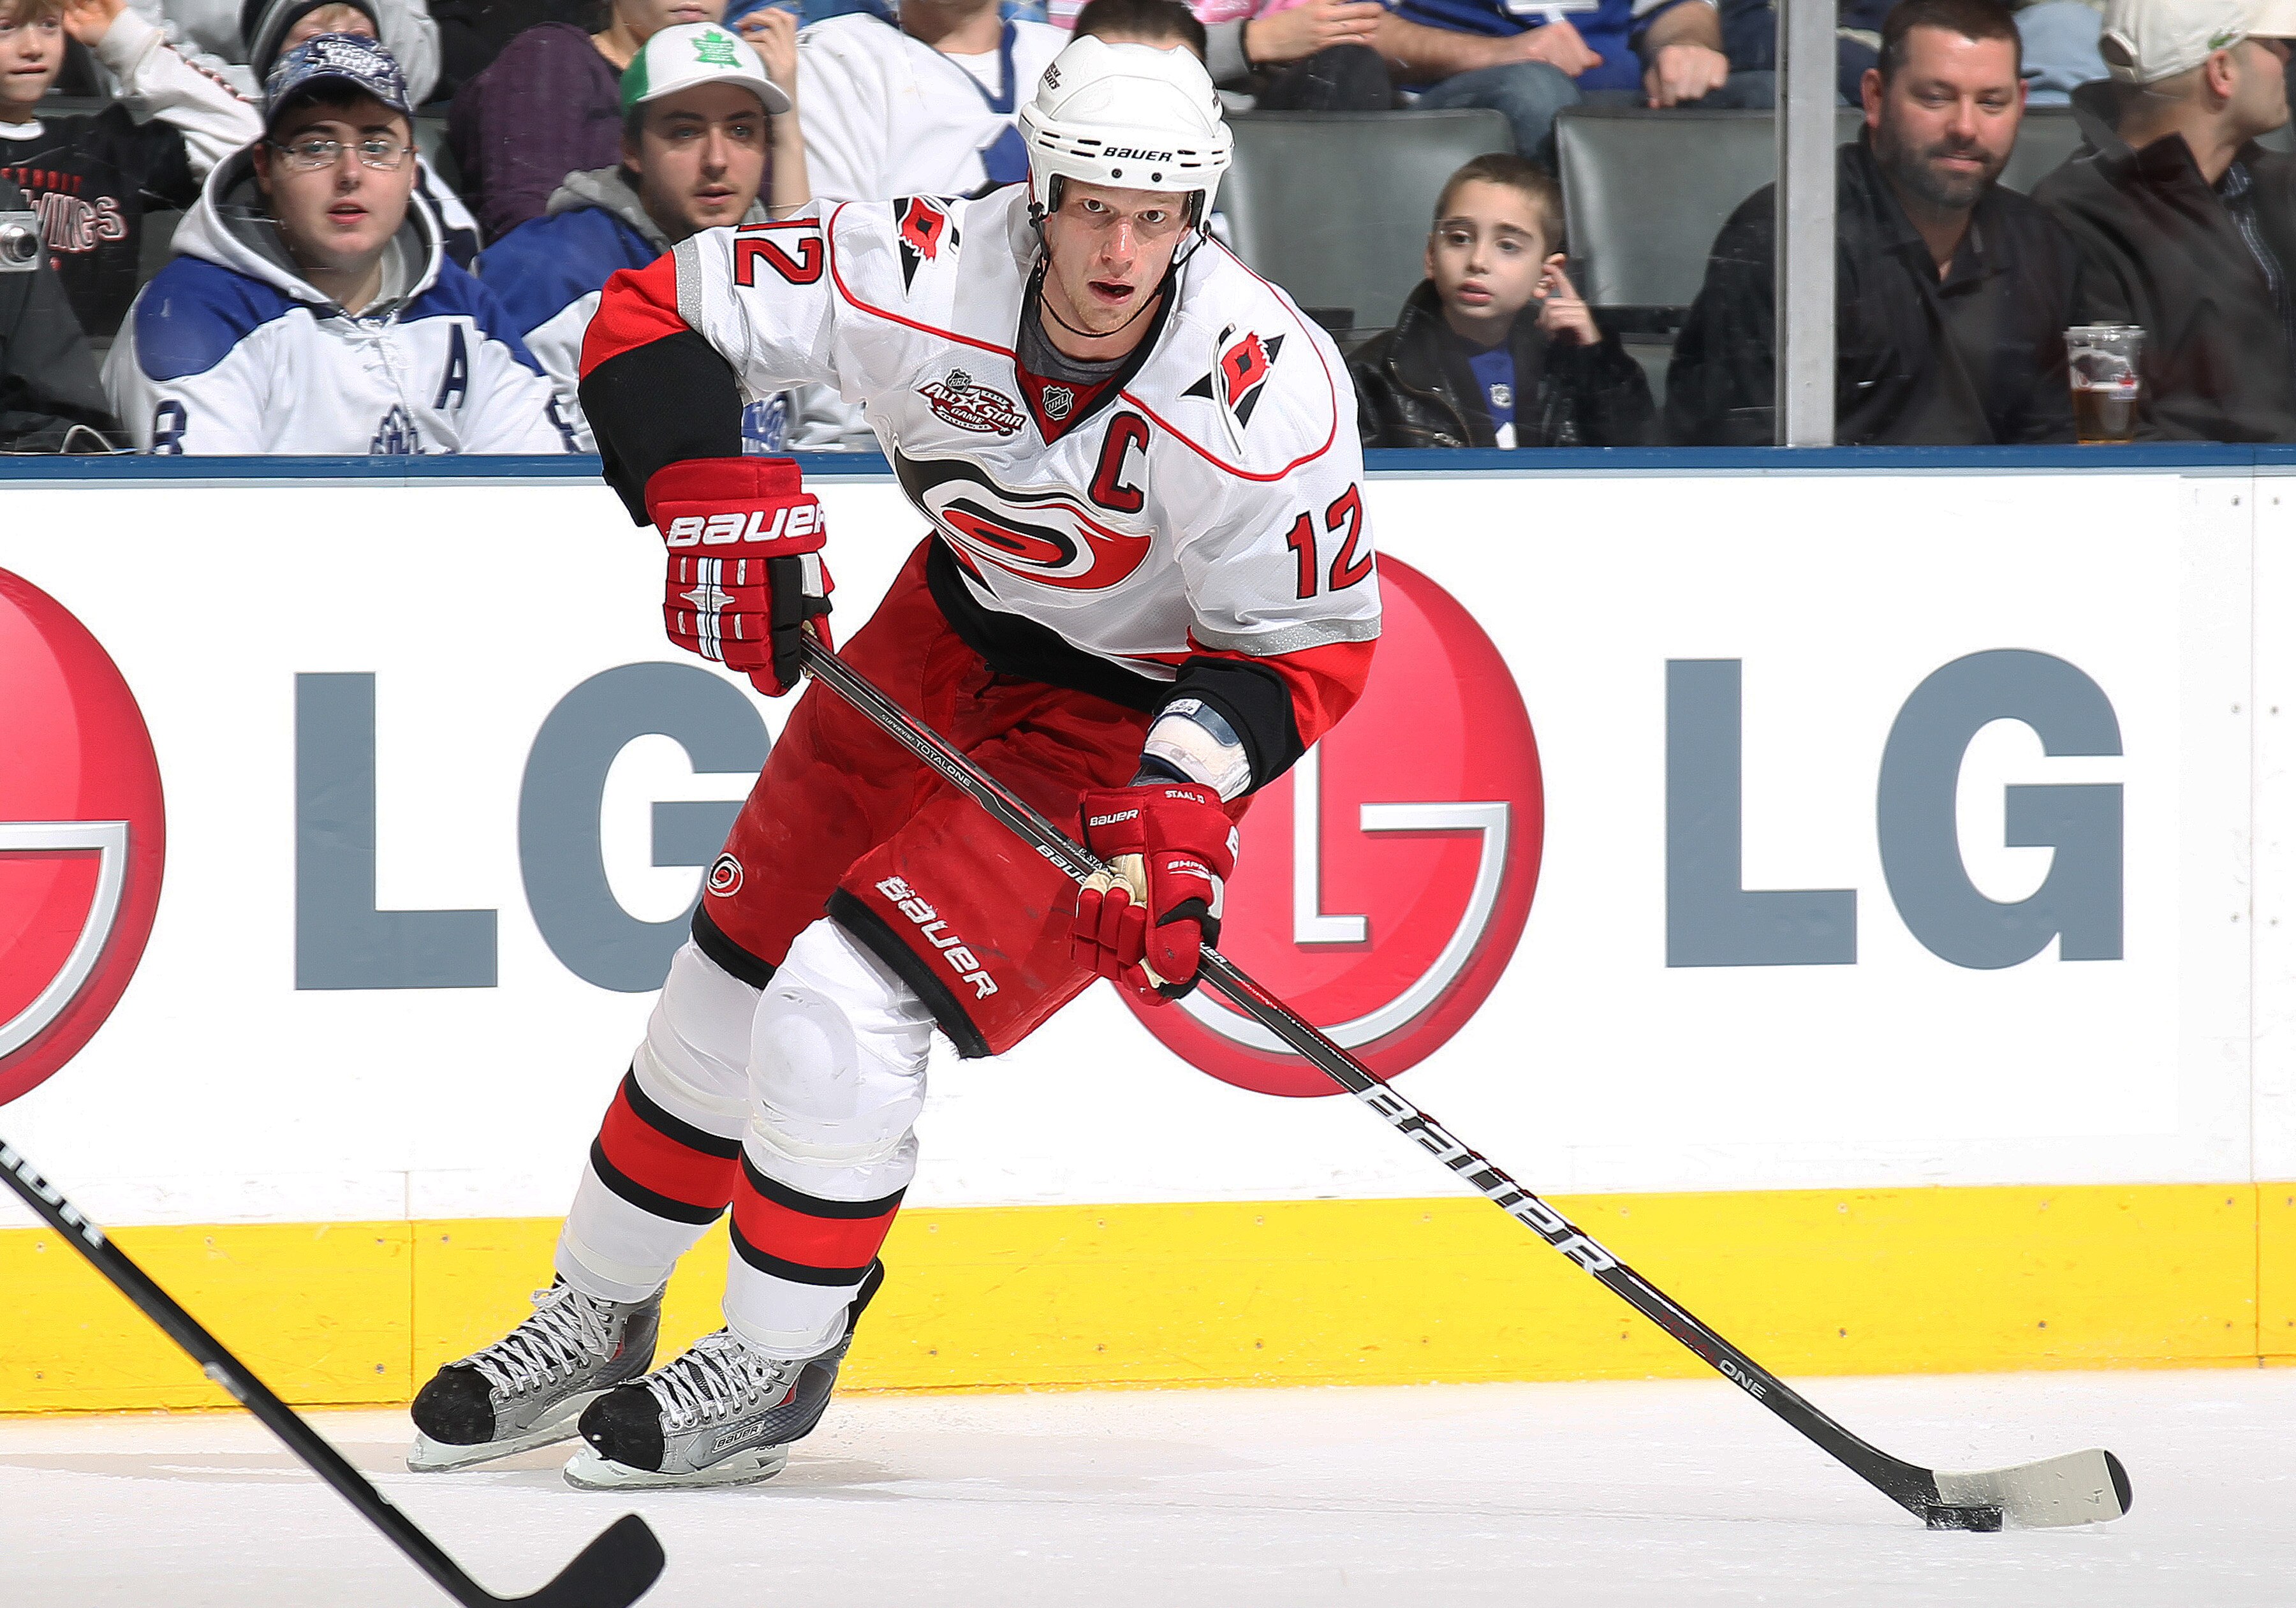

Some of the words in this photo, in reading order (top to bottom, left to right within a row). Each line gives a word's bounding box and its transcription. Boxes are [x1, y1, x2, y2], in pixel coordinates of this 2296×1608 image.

[1103, 147, 1173, 162] BAUER
[434, 322, 468, 409] A
[925, 383, 959, 404] ALL
[976, 406, 1024, 426] STAR
[950, 408, 985, 424] GAME
[1048, 395, 1068, 411] NHL
[1087, 411, 1150, 514] C
[1286, 482, 1373, 600] 12
[1165, 790, 1196, 801] STAAL
[1666, 647, 2124, 970] LG
[1089, 809, 1139, 827] BAUER
[1035, 845, 1087, 886] BAUE
[875, 876, 999, 999] BAUER
[1200, 942, 1228, 963] UER
[1357, 1084, 1619, 1277] BAUER
[1719, 1359, 1767, 1400] ONE
[717, 1425, 759, 1448] BAUER
